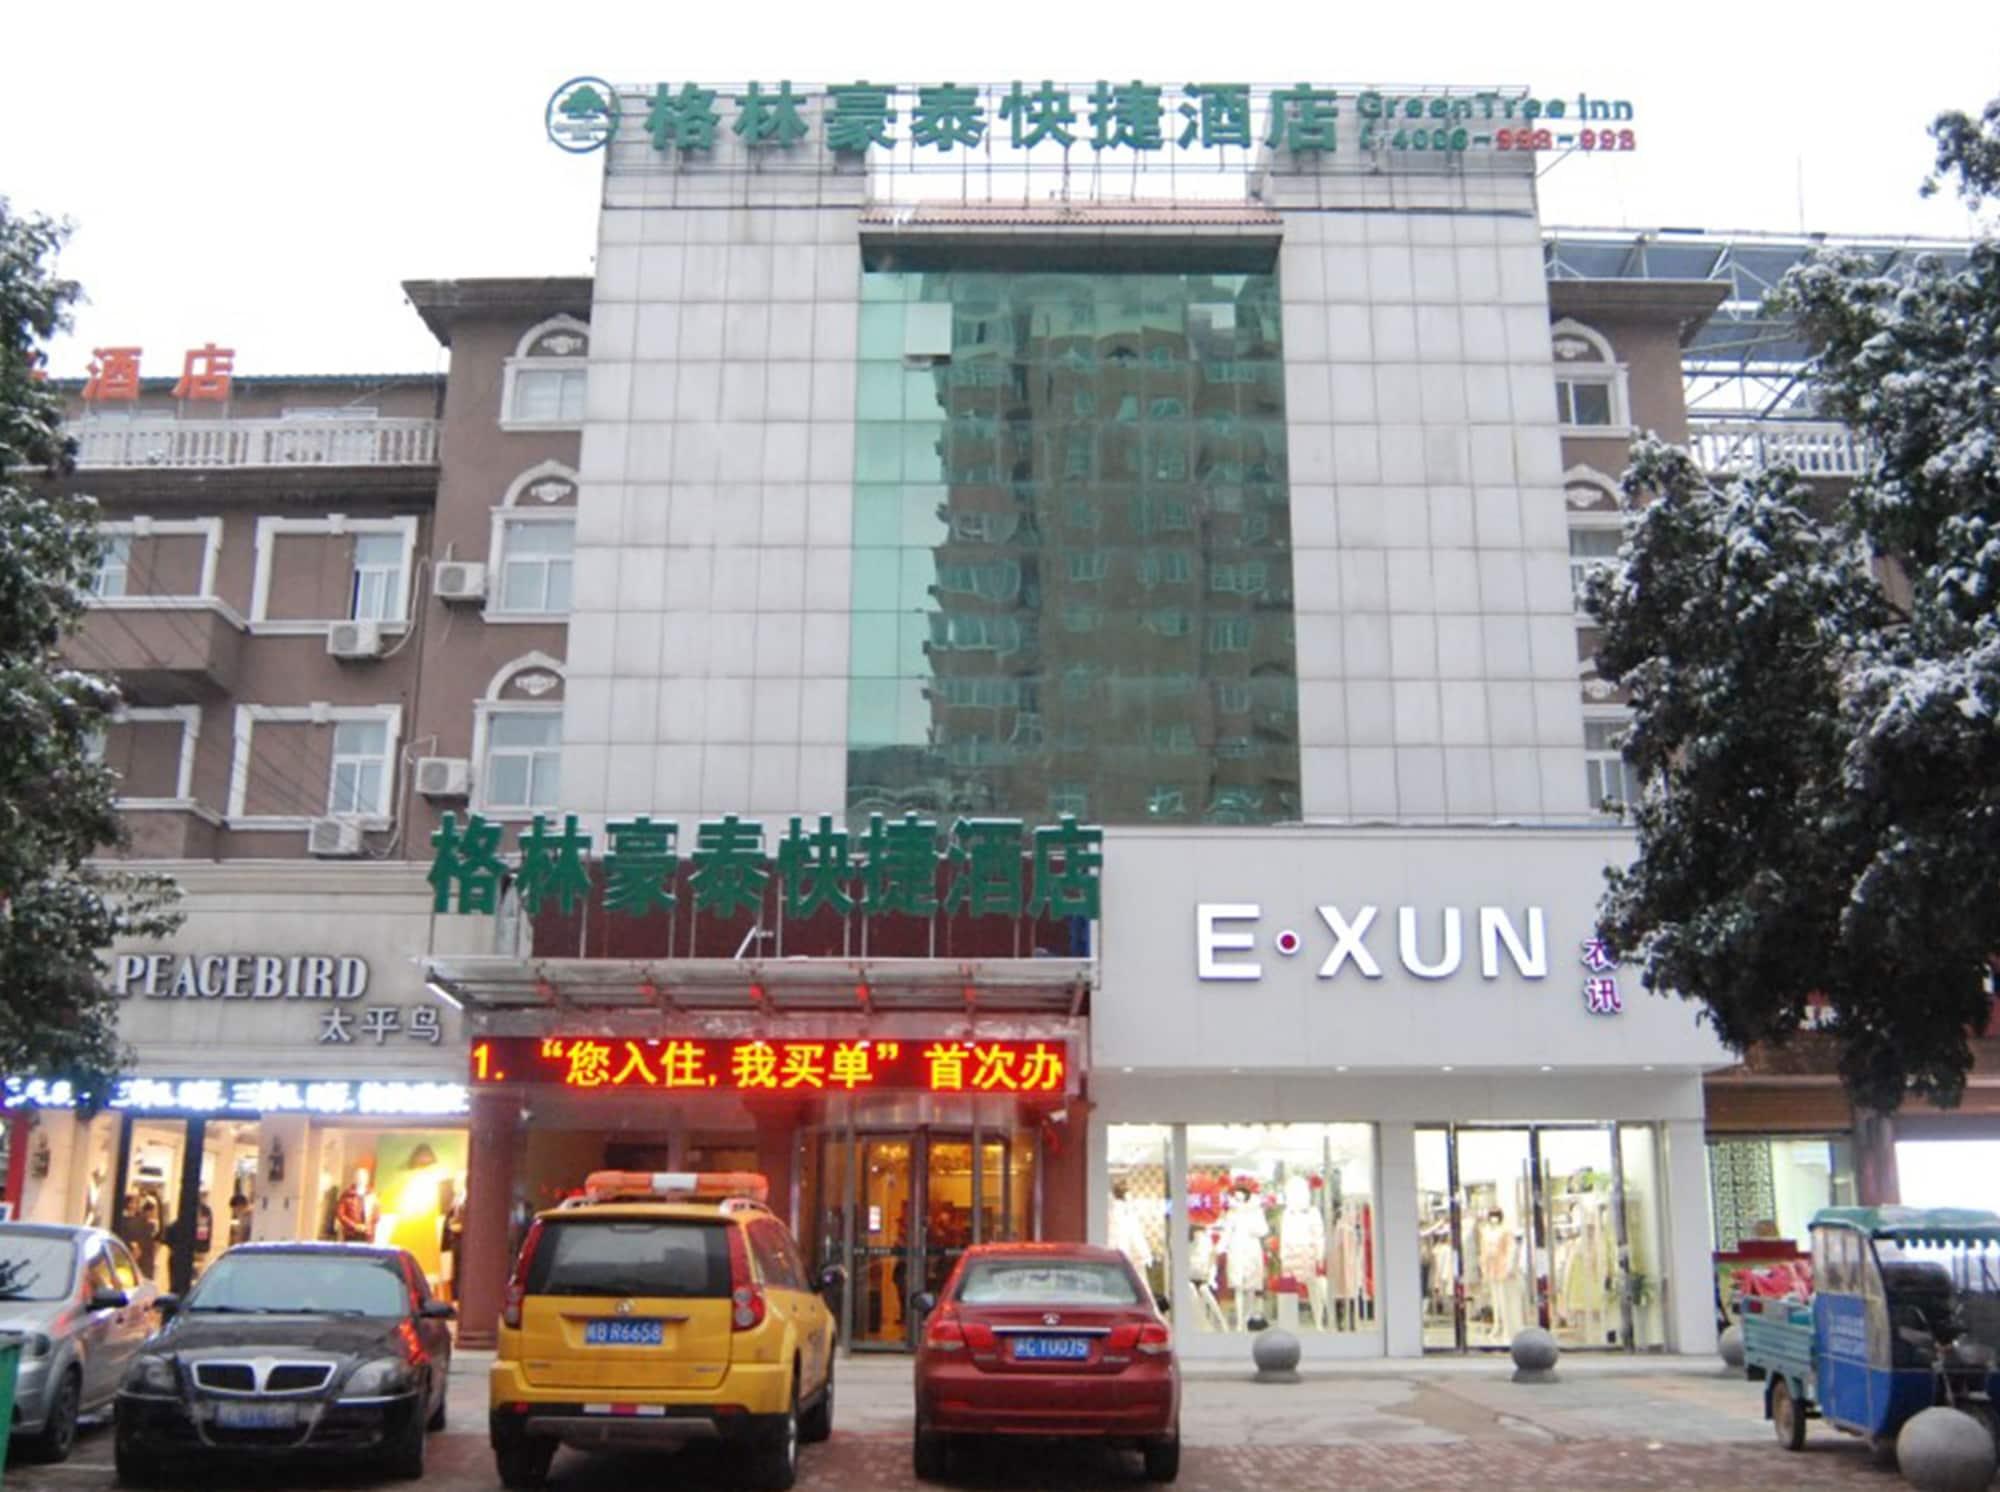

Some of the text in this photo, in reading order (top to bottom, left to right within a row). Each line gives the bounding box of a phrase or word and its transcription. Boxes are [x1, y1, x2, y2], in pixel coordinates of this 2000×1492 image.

[643, 80, 1338, 153] 格林豪泰快捷酒店
[1357, 91, 1634, 120] GreenTree Inn
[26, 343, 236, 400] 酒店
[427, 811, 1102, 920] 格林豪泰快捷酒店
[115, 954, 369, 1000] PEACEBIRD
[319, 1006, 443, 1046] 太平鸟
[924, 1043, 1065, 1090] 首次办
